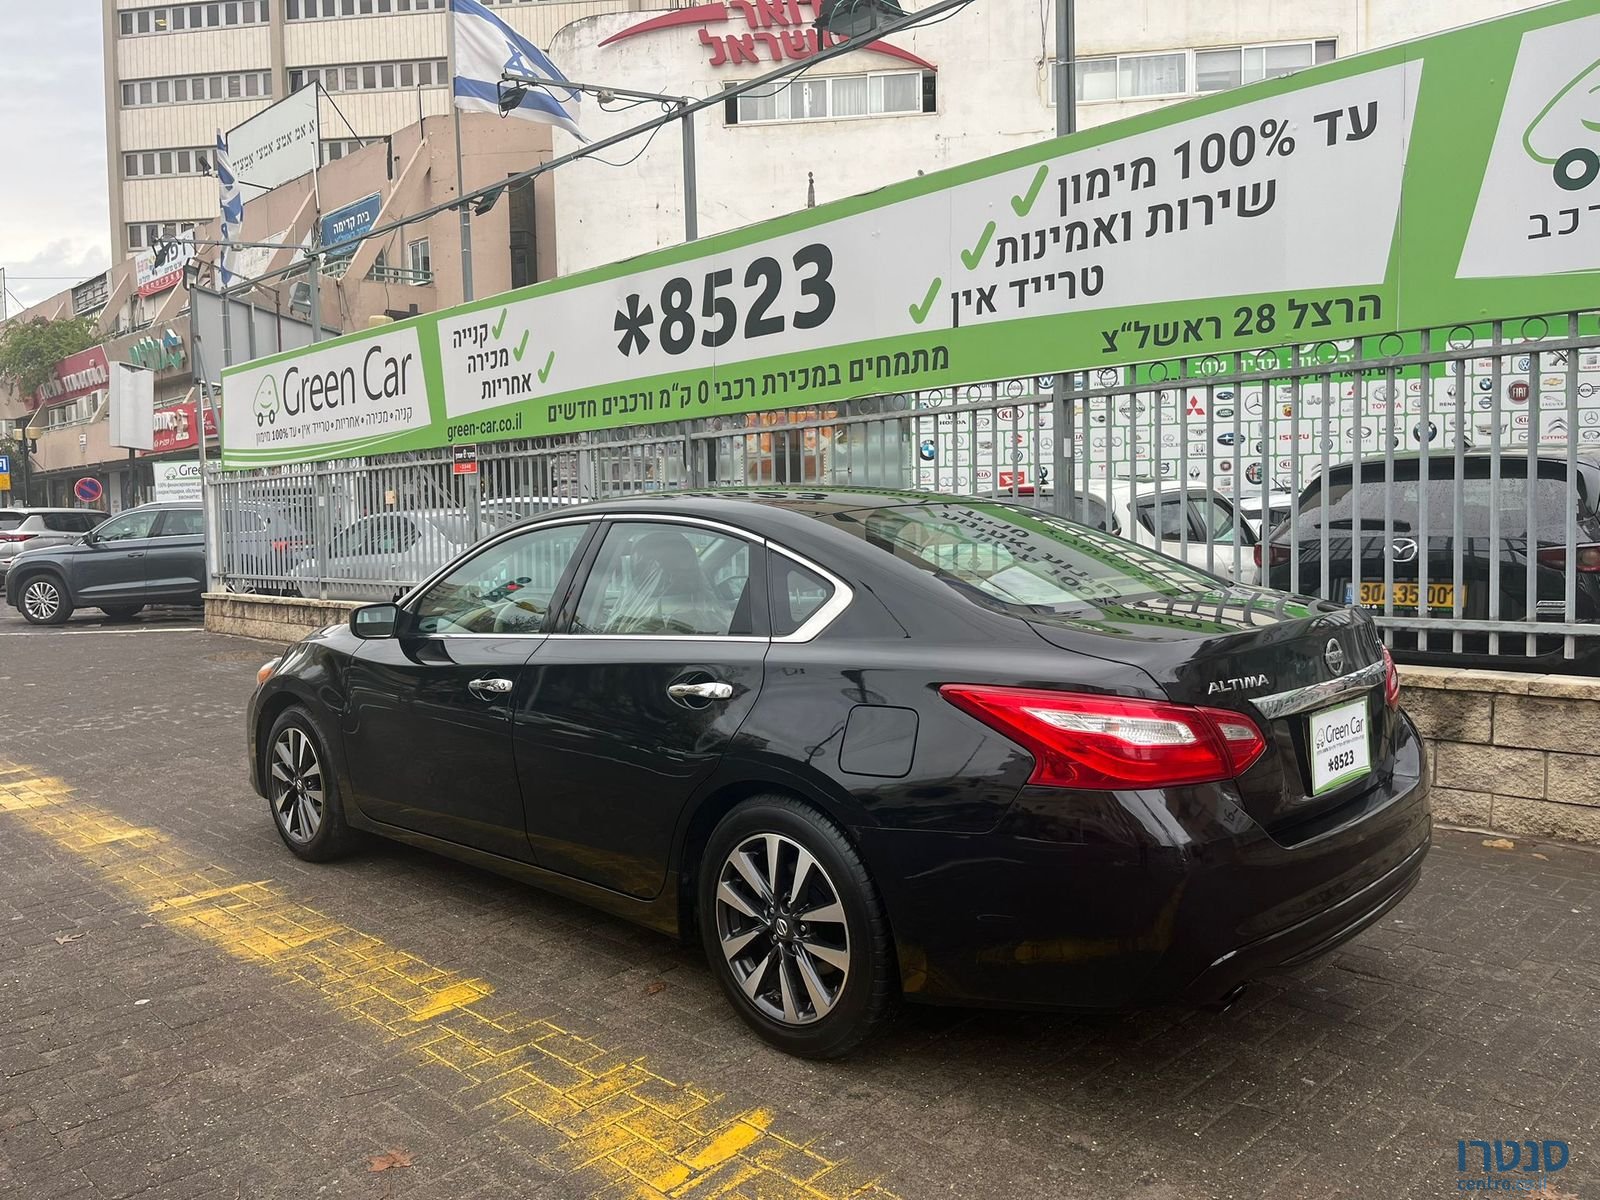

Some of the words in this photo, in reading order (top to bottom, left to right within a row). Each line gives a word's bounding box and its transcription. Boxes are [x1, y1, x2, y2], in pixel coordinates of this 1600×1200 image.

[730, 0, 820, 29] ואר
[1313, 100, 1379, 147] עד
[1173, 117, 1297, 181] 100%
[1057, 155, 1157, 217] מימון
[357, 211, 370, 226] בית
[1145, 178, 1277, 239] שירות
[333, 216, 356, 235] קדימה
[995, 208, 1133, 268] ואמינות
[1009, 264, 1104, 308] טרייד
[951, 282, 998, 329] אין
[1287, 294, 1382, 329] הרצל
[1233, 302, 1275, 337] 28
[453, 323, 489, 349] קנייה
[468, 348, 509, 373] מכירה
[849, 345, 949, 382] מתמחים
[283, 366, 356, 416] Green
[363, 345, 412, 400] Car
[481, 373, 532, 400] אחריות
[697, 380, 709, 404] 0
[714, 377, 755, 402] רכבי
[762, 364, 842, 396] במכירת
[1512, 385, 1527, 398] FIAT
[395, 407, 413, 423] קניה
[548, 399, 597, 423] חדשים
[602, 391, 653, 416] ורכבים
[301, 423, 311, 439] אין
[312, 420, 330, 434] טרייד
[335, 416, 360, 431] אחריות
[366, 411, 389, 426] מכירה
[447, 412, 522, 442] green-car.co.il
[272, 429, 289, 441] 100%
[1208, 673, 1270, 695] ALTIMA
[1325, 724, 1350, 743] Green
[1350, 716, 1364, 735] Car
